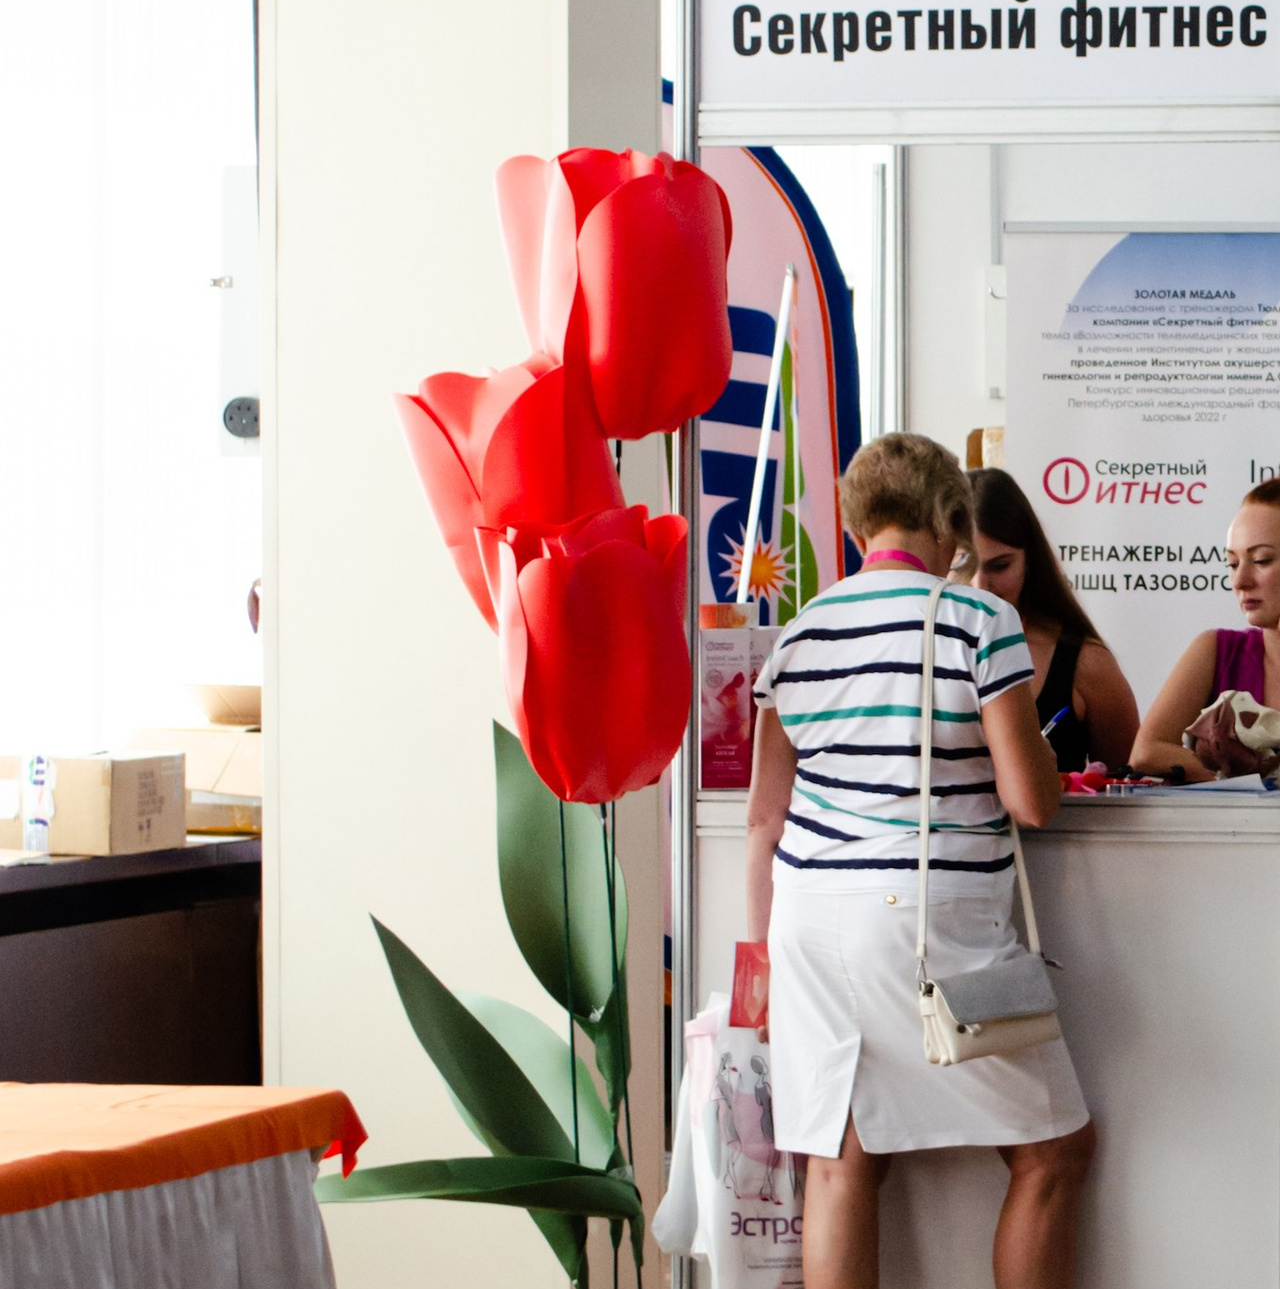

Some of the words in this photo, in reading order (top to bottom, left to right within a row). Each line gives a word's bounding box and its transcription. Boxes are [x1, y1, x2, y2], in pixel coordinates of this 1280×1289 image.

[1134, 289, 1186, 299] ЗОЛОТАЯ
[1189, 289, 1236, 300] МЕДАЛЬ
[1066, 304, 1079, 313] За
[1082, 305, 1166, 314] исследование
[1180, 305, 1254, 314] тренажером
[1093, 318, 1149, 327] компании
[1042, 331, 1070, 340] тема
[1157, 331, 1258, 342] телемедицинских
[1070, 359, 1148, 368] проведенное
[1151, 358, 1220, 369] Институтом
[1042, 373, 1112, 381] гинекологии
[1226, 373, 1263, 381] имени
[1086, 385, 1133, 396] Конкурс
[1068, 397, 1154, 410] Петербургский
[1157, 400, 1254, 410] международный
[1141, 414, 1191, 423] здоровья
[1194, 413, 1219, 422] 2022
[1095, 459, 1207, 479] Секретный
[1059, 545, 1183, 562] ТРЕНАЖЕРЫ
[1068, 574, 1117, 592] ЫШЦ
